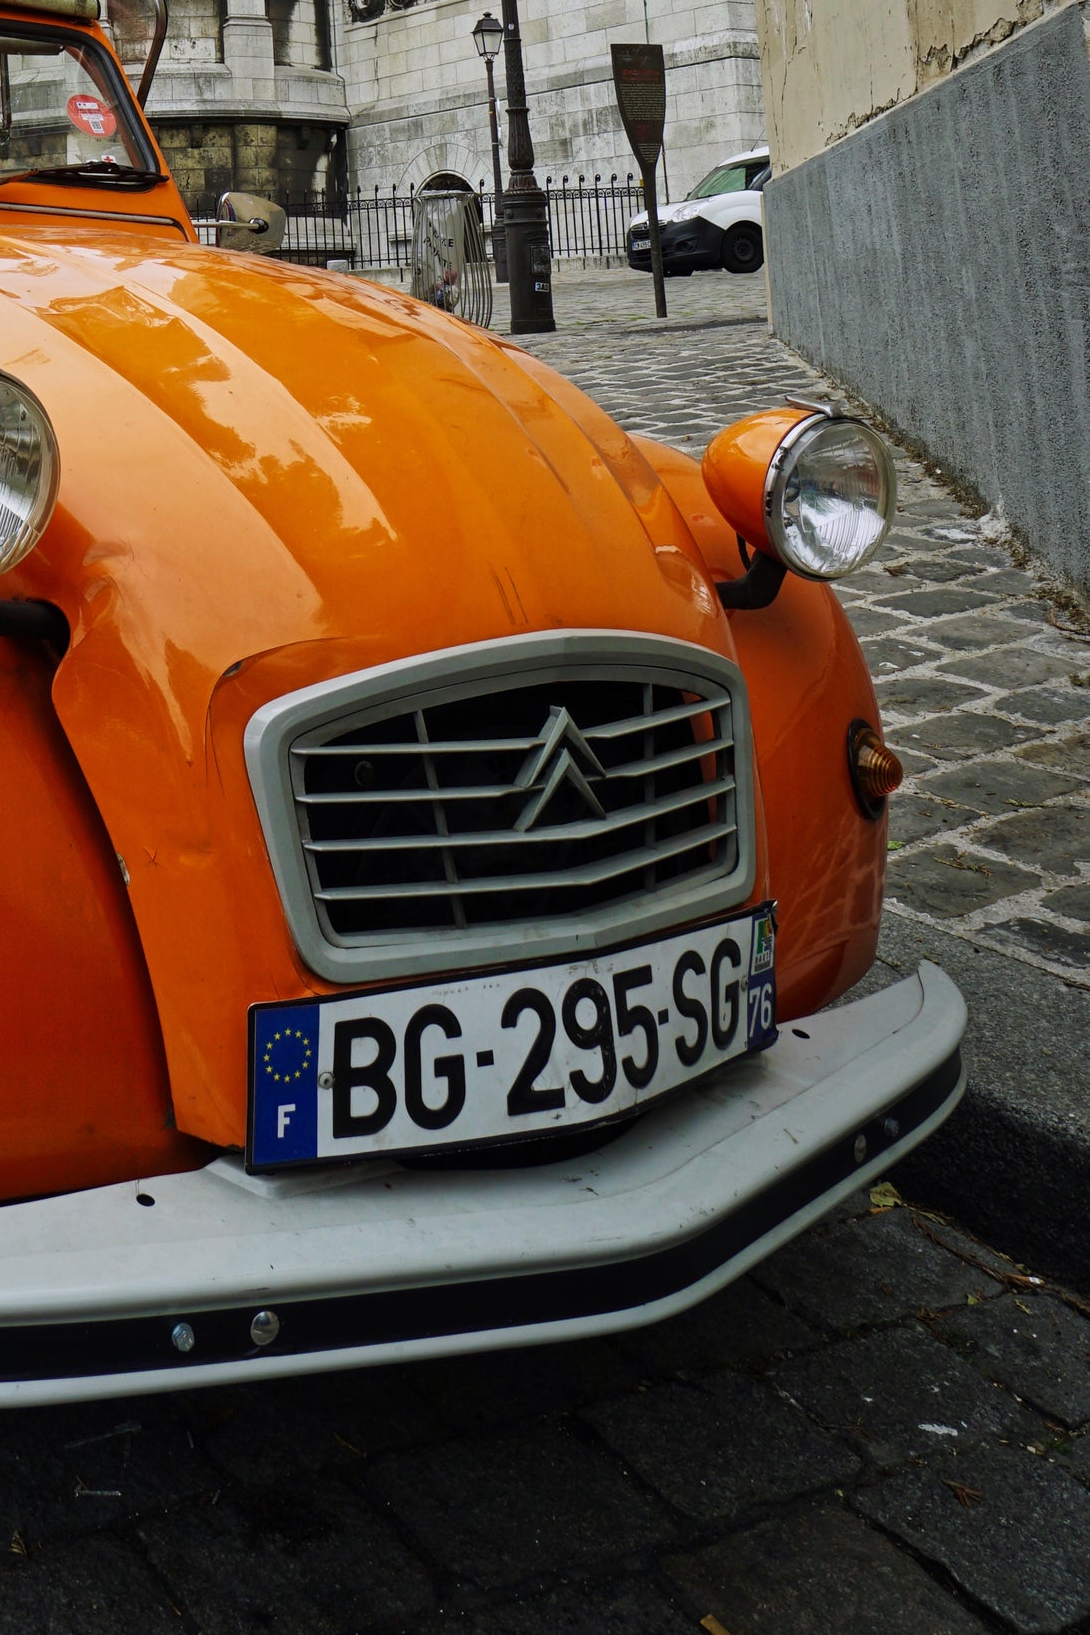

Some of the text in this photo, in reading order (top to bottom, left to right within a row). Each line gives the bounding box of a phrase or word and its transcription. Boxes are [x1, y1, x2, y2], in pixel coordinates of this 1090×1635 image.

[749, 983, 773, 1037] 76
[333, 937, 742, 1139] BG-295-SG
[277, 1103, 296, 1138] F
